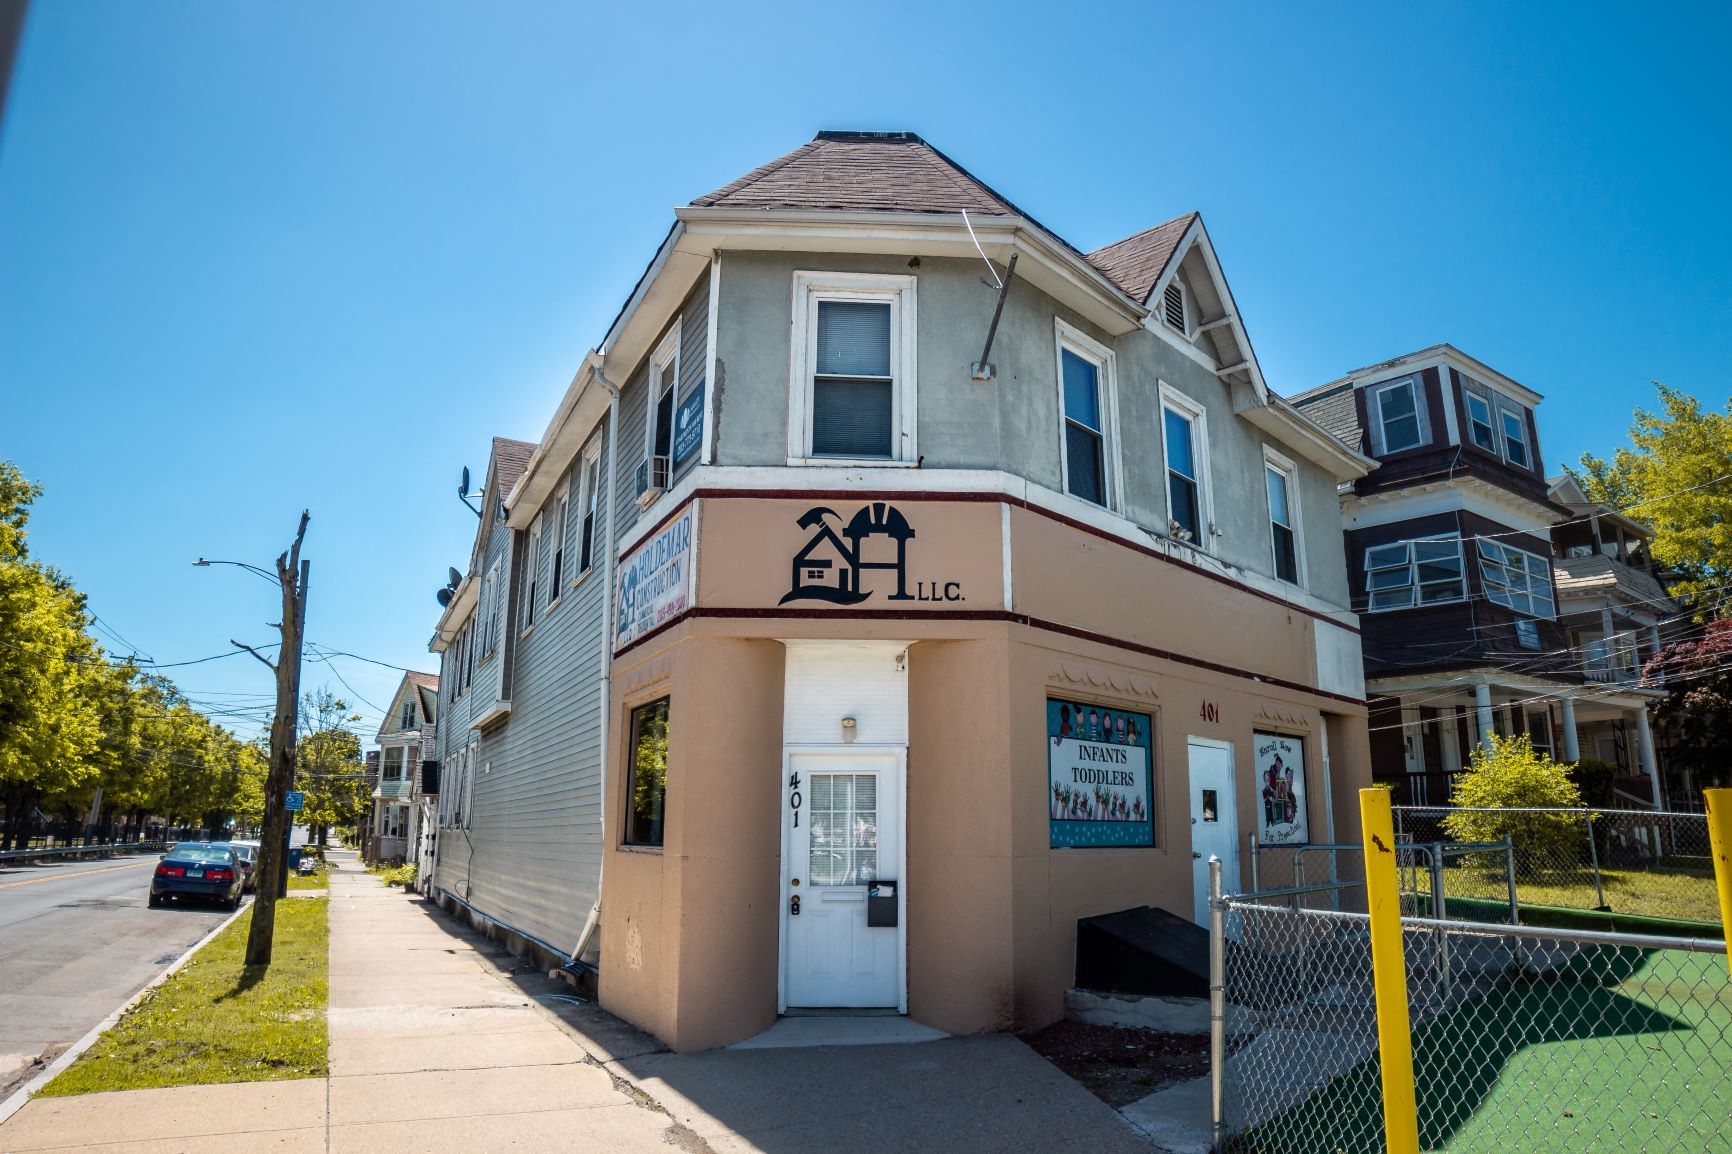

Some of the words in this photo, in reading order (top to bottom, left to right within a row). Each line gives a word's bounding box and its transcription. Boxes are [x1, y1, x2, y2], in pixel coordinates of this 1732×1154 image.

[638, 516, 690, 583] HOLDEMAR
[636, 559, 682, 611] CONSTRUCTION
[917, 582, 966, 601] LLC.
[1200, 699, 1219, 723] 401
[1078, 744, 1127, 764] INFANTS
[1260, 740, 1277, 757] Enroll
[1072, 767, 1135, 787] TODDLERS
[789, 771, 802, 828] 401
